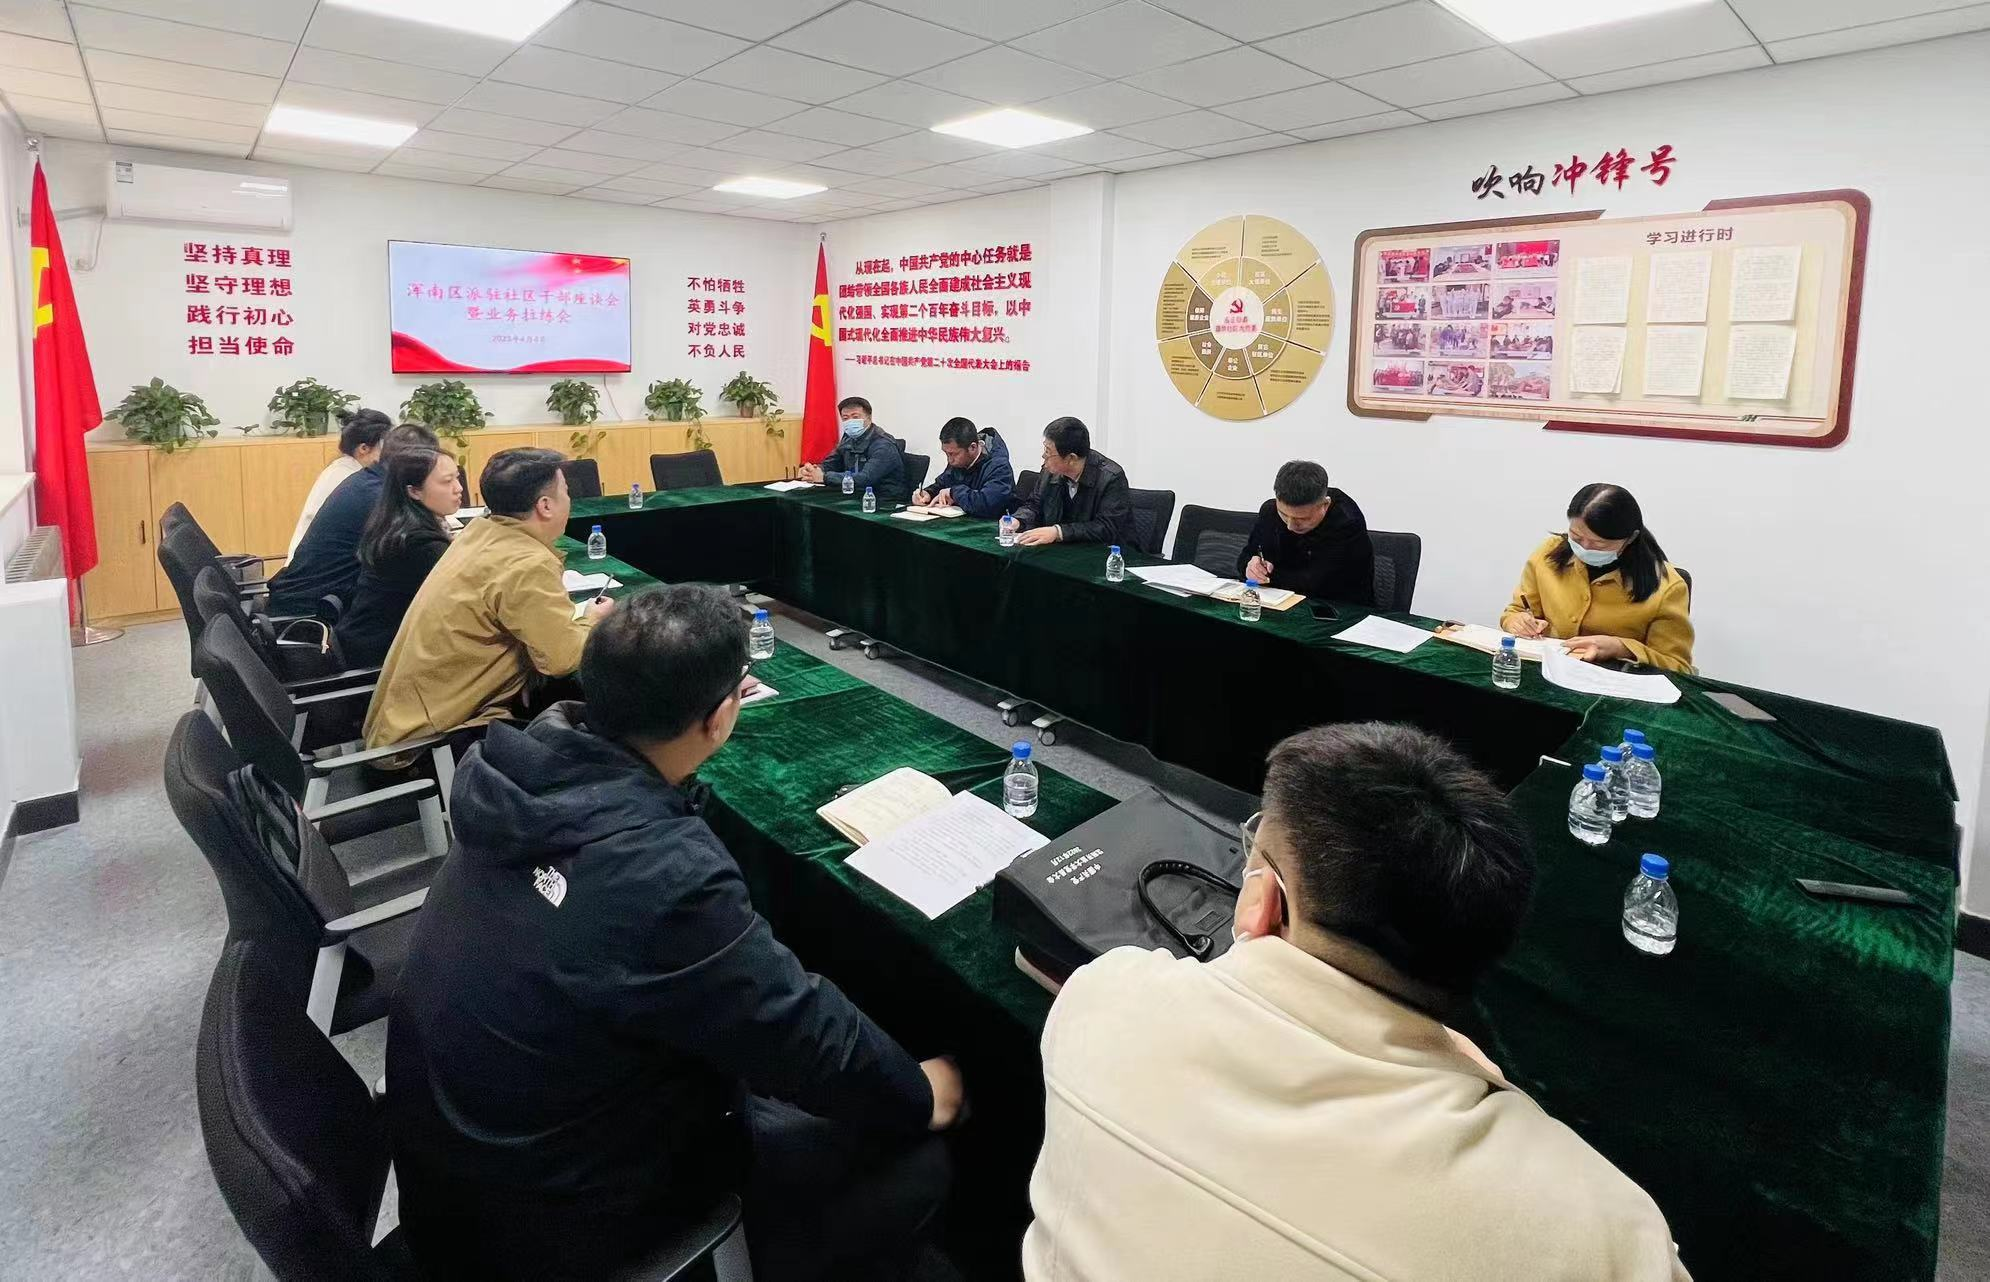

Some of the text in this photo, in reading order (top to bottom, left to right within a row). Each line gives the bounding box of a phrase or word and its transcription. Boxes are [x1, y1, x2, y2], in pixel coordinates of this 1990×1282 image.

[1471, 144, 1677, 200] 吹响冲锋号
[1646, 227, 1733, 245] 学习进行时
[184, 242, 292, 268] 坚持真理
[185, 273, 293, 297] 坚守理想
[407, 282, 620, 307] 浑南区派驻社区干部座谈会
[687, 277, 745, 293] 不怕牺牲
[187, 305, 294, 326] 践行初心
[687, 299, 745, 315] 英勇斗争
[687, 321, 746, 336] 对党忠诚
[188, 335, 295, 356] 担当使命
[688, 344, 745, 358] 不负人民
